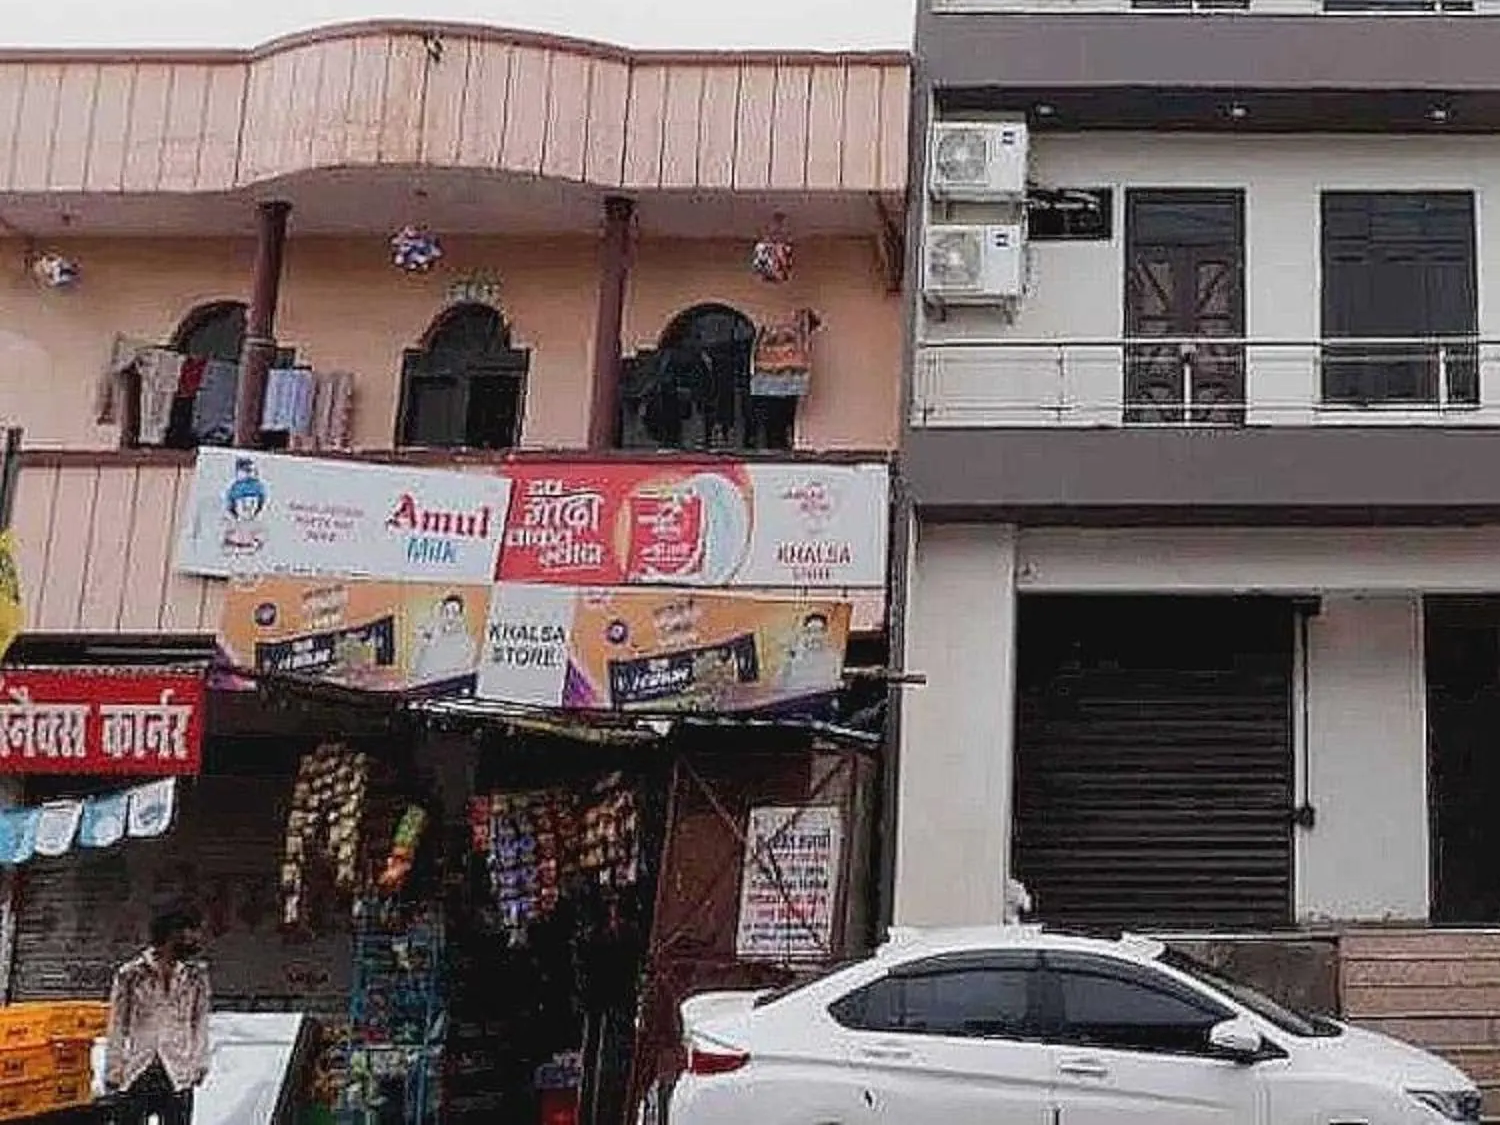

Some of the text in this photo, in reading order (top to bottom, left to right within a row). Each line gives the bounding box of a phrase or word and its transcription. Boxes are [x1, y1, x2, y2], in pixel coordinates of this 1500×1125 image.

[386, 492, 491, 539] Amul
[405, 536, 456, 564] Milk
[489, 625, 566, 645] KHALSA
